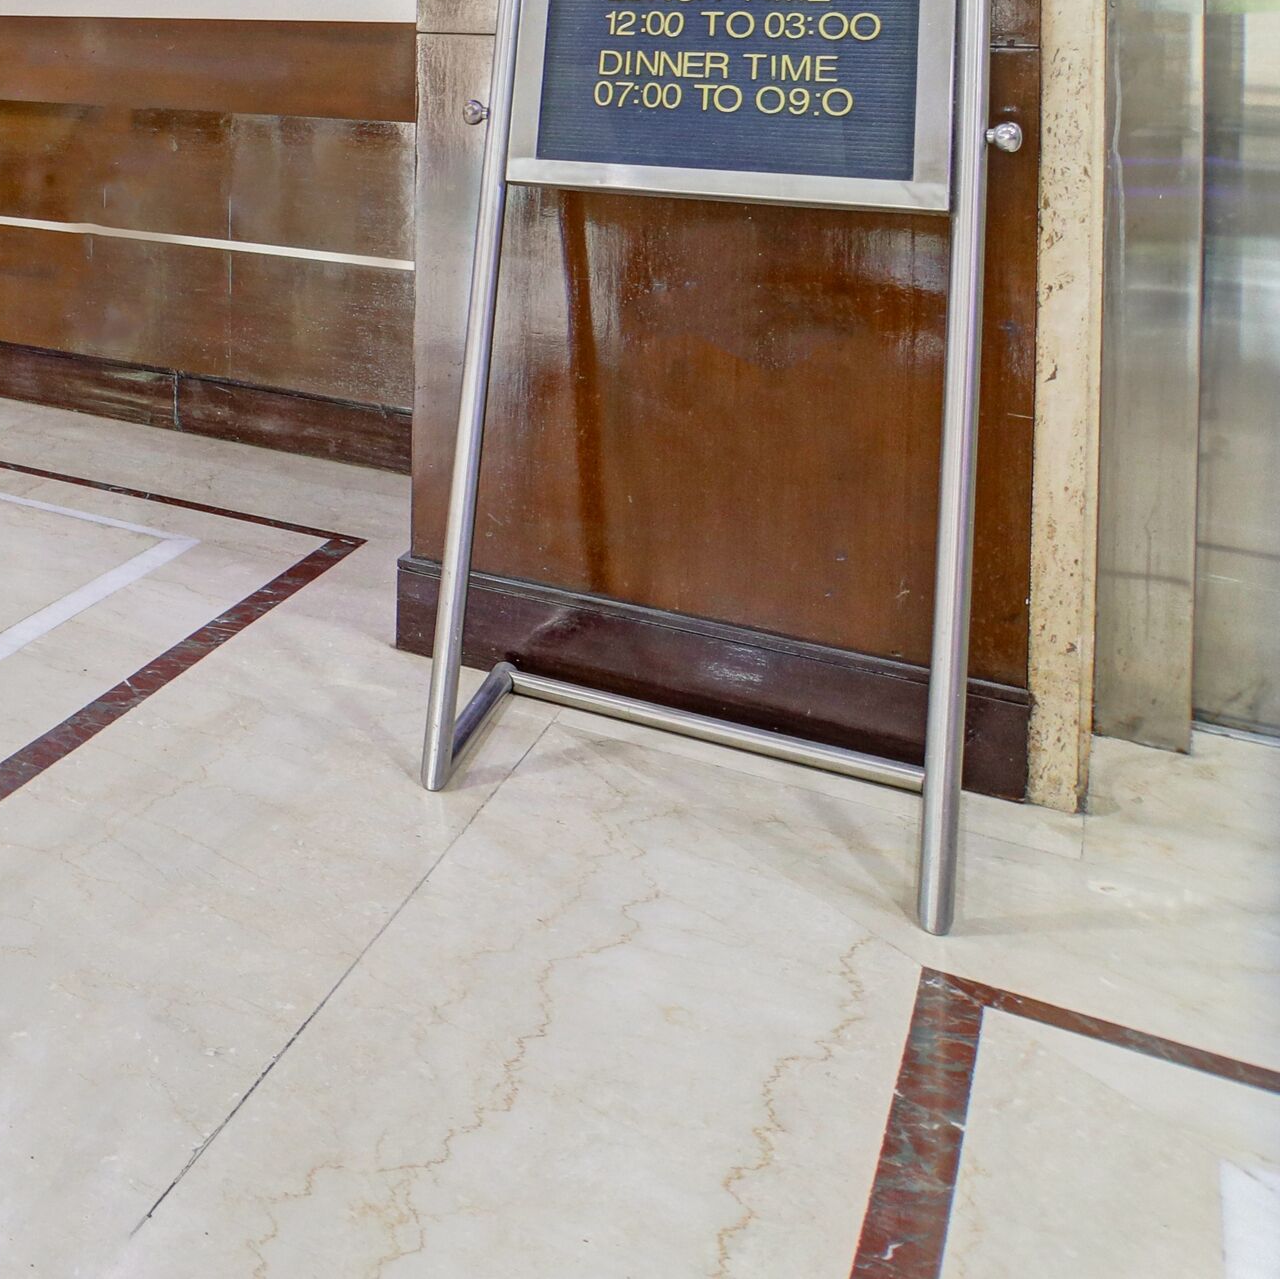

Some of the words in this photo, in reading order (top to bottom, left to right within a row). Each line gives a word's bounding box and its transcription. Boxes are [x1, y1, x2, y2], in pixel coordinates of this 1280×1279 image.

[605, 10, 685, 38] 12:00
[700, 10, 755, 39] TO
[597, 49, 730, 80] DINNER
[742, 52, 839, 83] TIME
[593, 80, 683, 110] 07:00
[694, 83, 743, 114] TO
